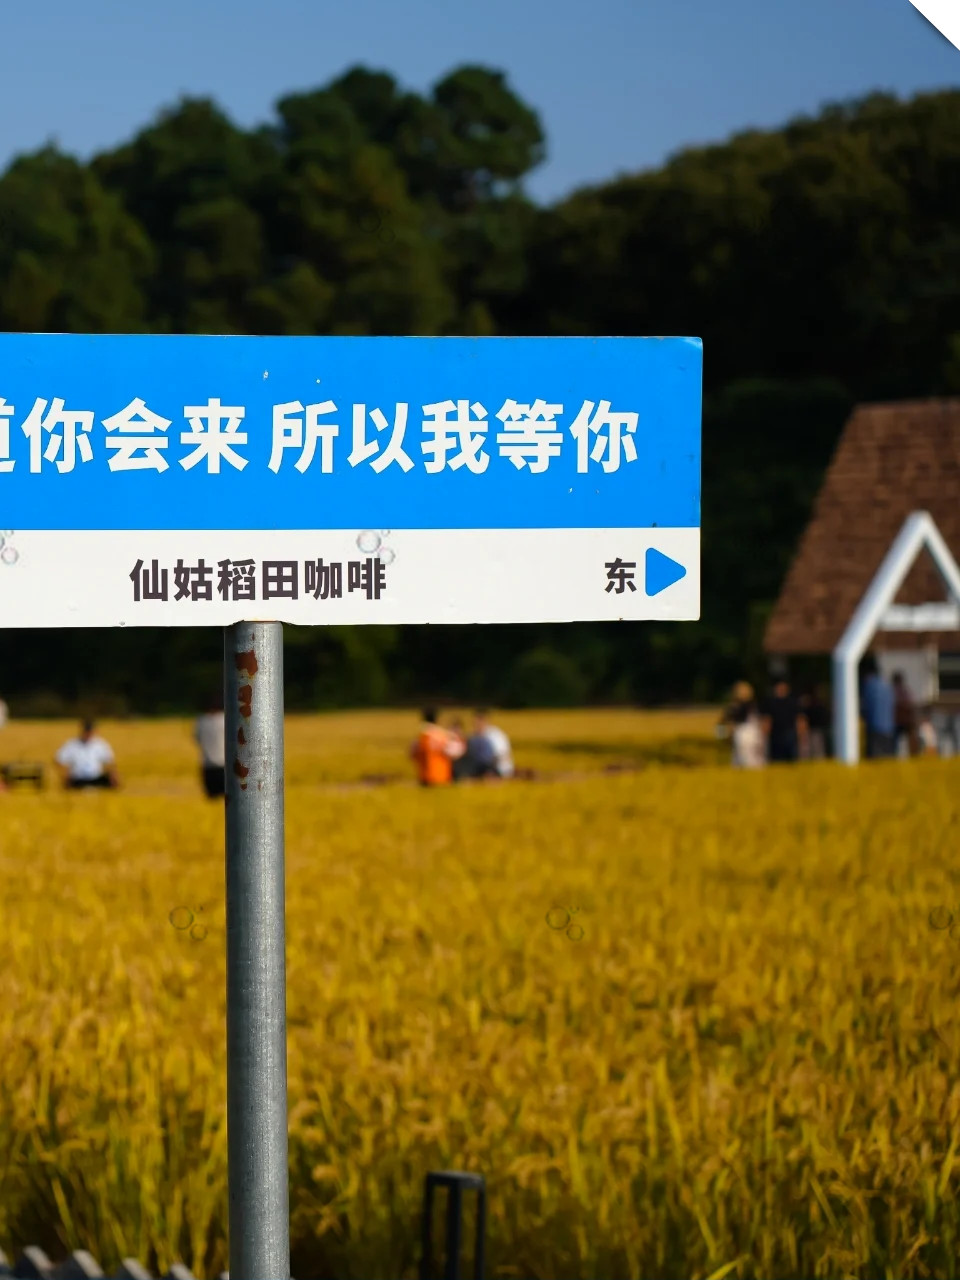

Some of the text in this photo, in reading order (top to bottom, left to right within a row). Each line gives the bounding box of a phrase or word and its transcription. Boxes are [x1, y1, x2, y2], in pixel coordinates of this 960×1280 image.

[267, 398, 639, 474] 所以我等你
[128, 557, 387, 601] 仙姑稻田咖啡
[604, 557, 637, 595] 东
